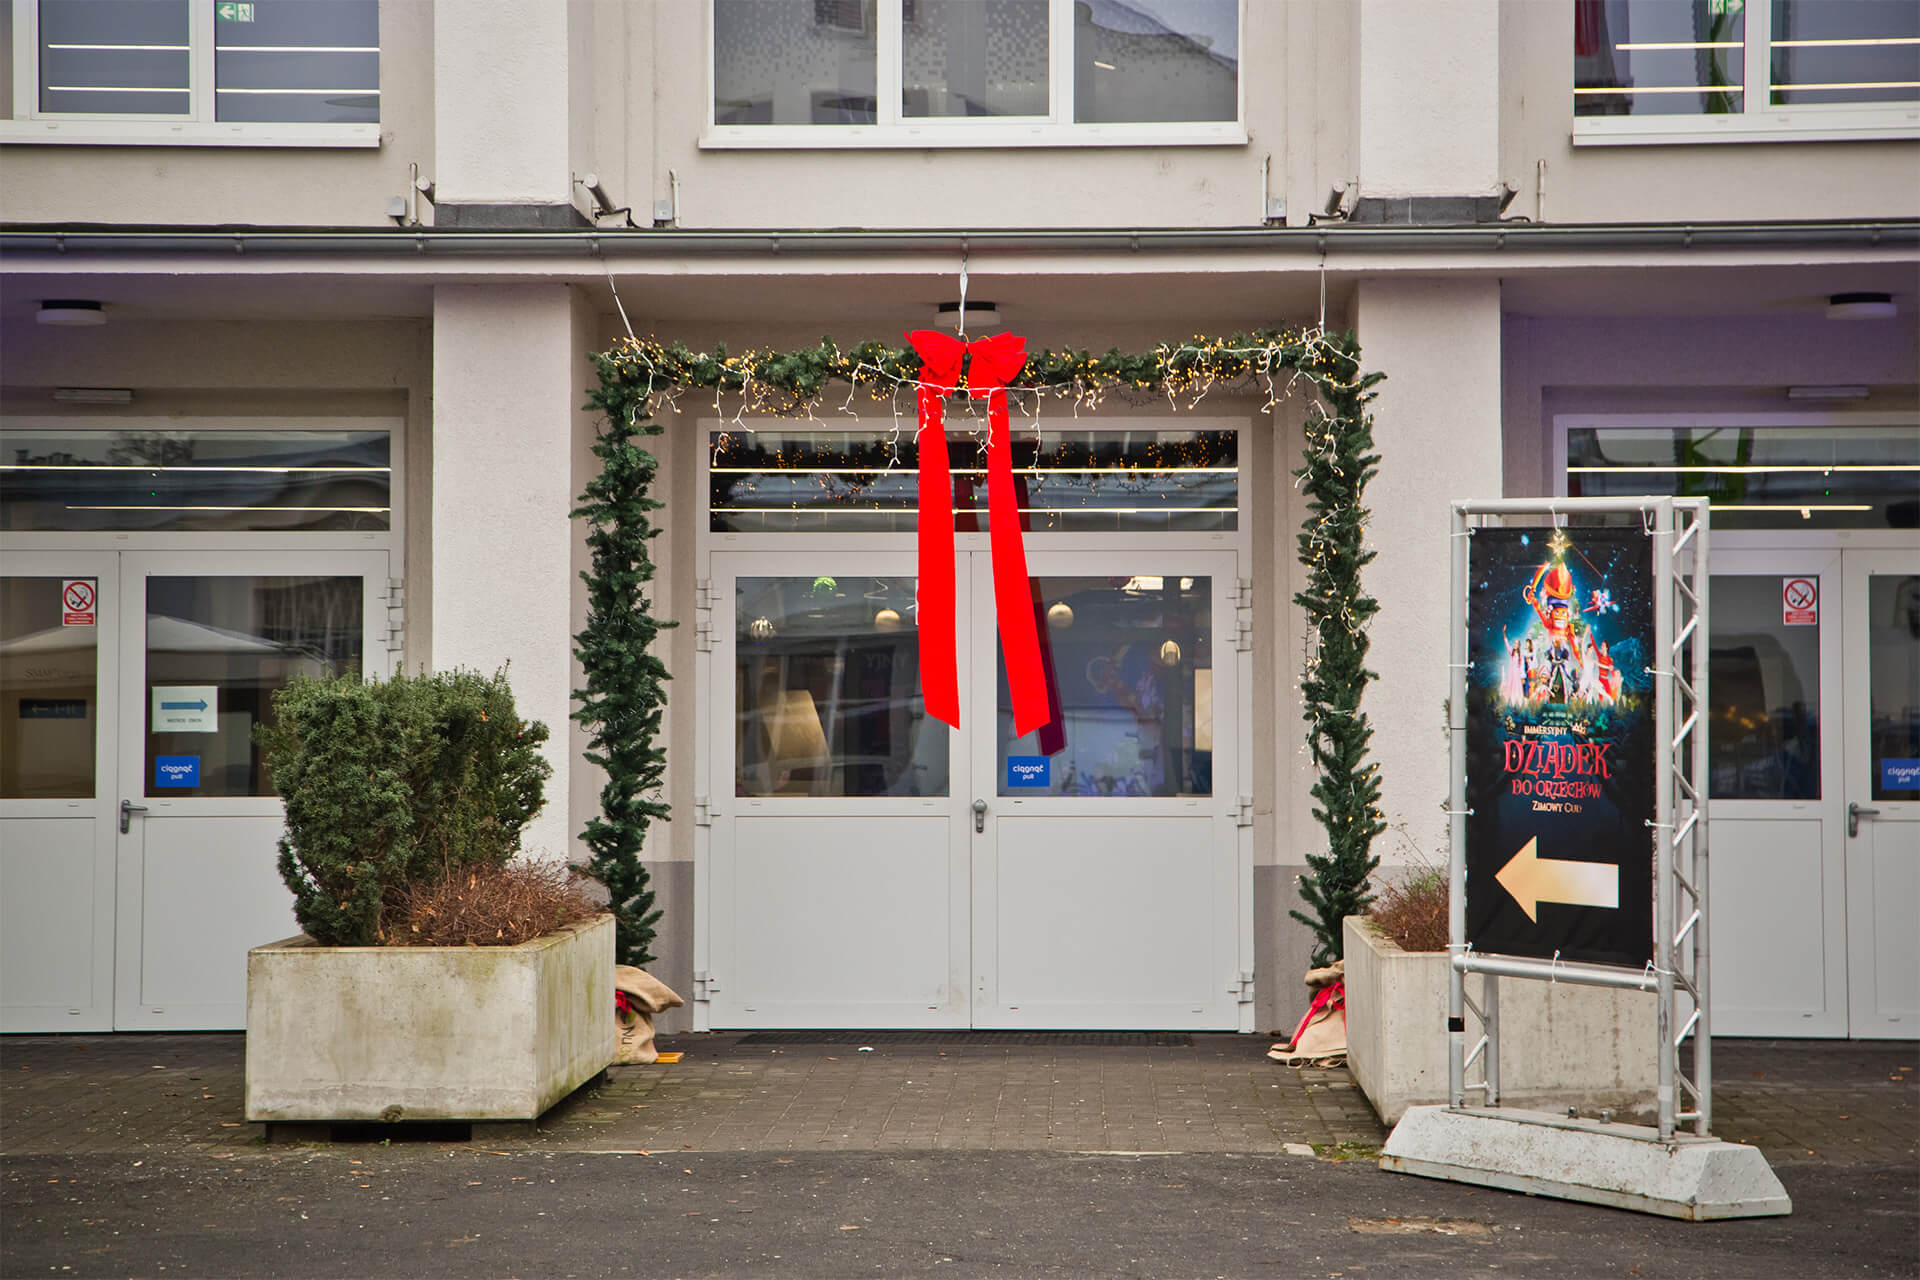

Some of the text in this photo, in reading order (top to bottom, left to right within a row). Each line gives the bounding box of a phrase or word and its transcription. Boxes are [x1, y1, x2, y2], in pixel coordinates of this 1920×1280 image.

[1523, 725, 1567, 736] IMMERSYJNY
[1503, 740, 1612, 779] DZIADEK
[1512, 779, 1602, 800] DO ORZECHÓW
[1532, 800, 1563, 813] ZIMOWY
